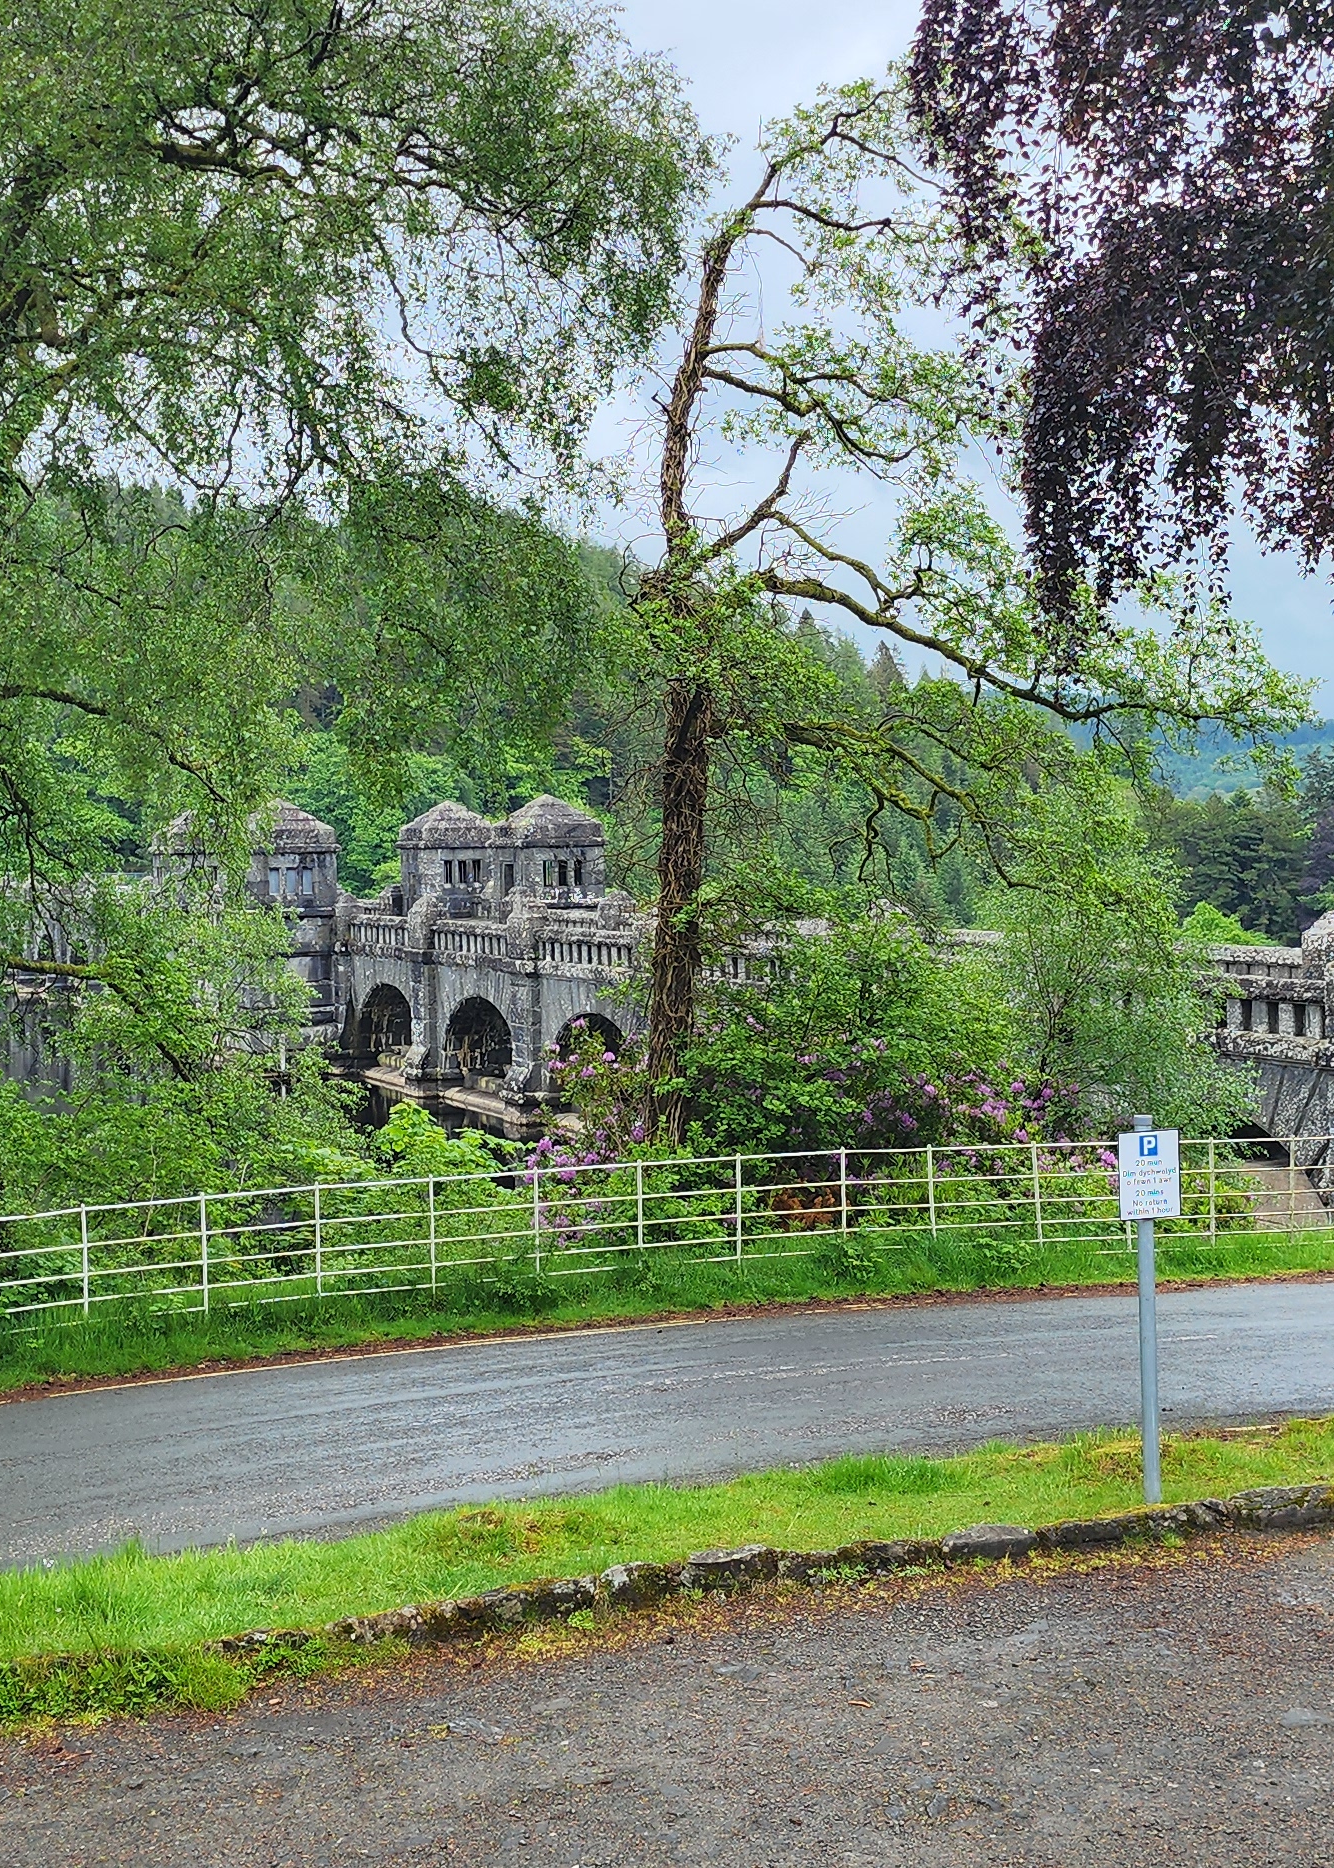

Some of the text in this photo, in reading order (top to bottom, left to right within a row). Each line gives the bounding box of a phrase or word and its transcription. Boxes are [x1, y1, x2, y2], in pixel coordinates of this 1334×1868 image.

[1142, 1136, 1156, 1156] P
[1135, 1159, 1146, 1167] 20
[1122, 1170, 1137, 1178] Dim
[1135, 1189, 1146, 1197] 20
[1145, 1198, 1168, 1206] return
[1126, 1208, 1150, 1216] within
